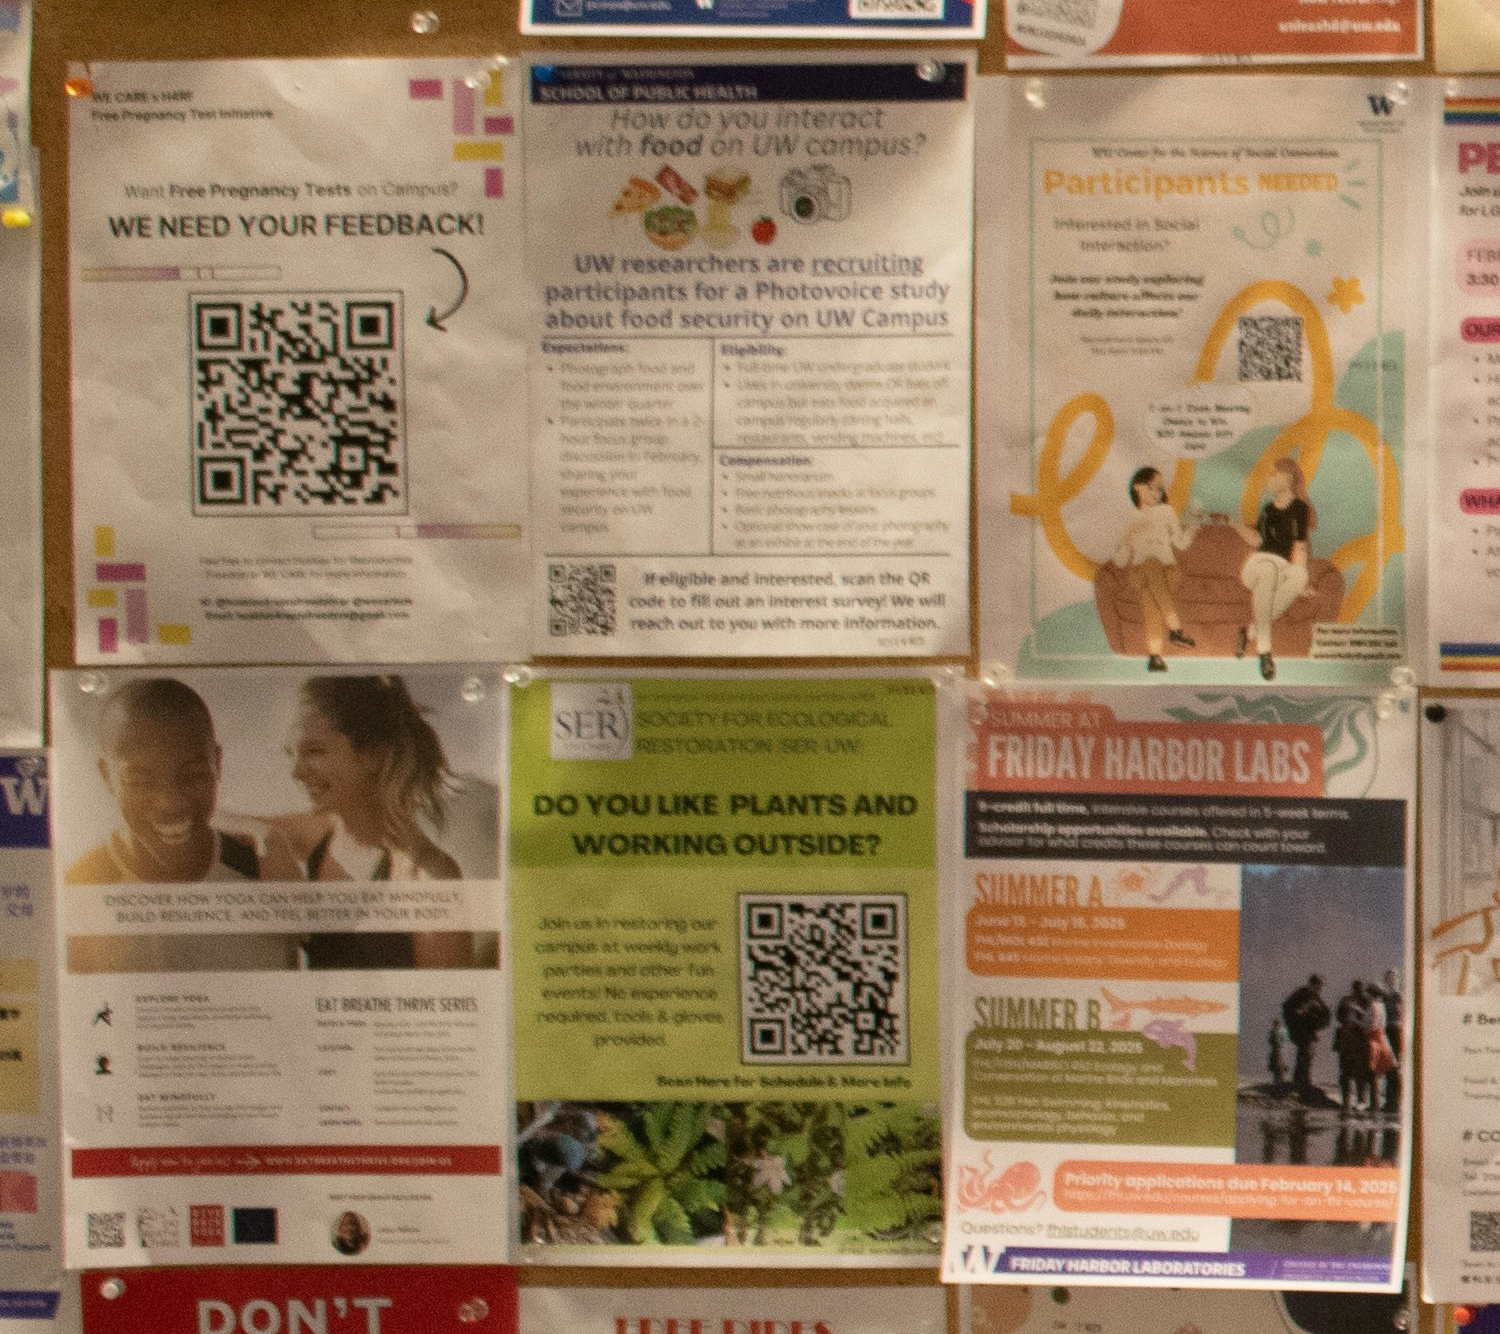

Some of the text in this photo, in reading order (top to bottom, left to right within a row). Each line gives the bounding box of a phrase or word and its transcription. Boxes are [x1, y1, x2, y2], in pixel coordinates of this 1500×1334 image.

[109, 214, 484, 238] WE NEED YOUR FEEDBACK!
[989, 738, 1313, 785] FRIDAY HARBOR LABS
[573, 833, 881, 858] WORKING OUTSIDE?
